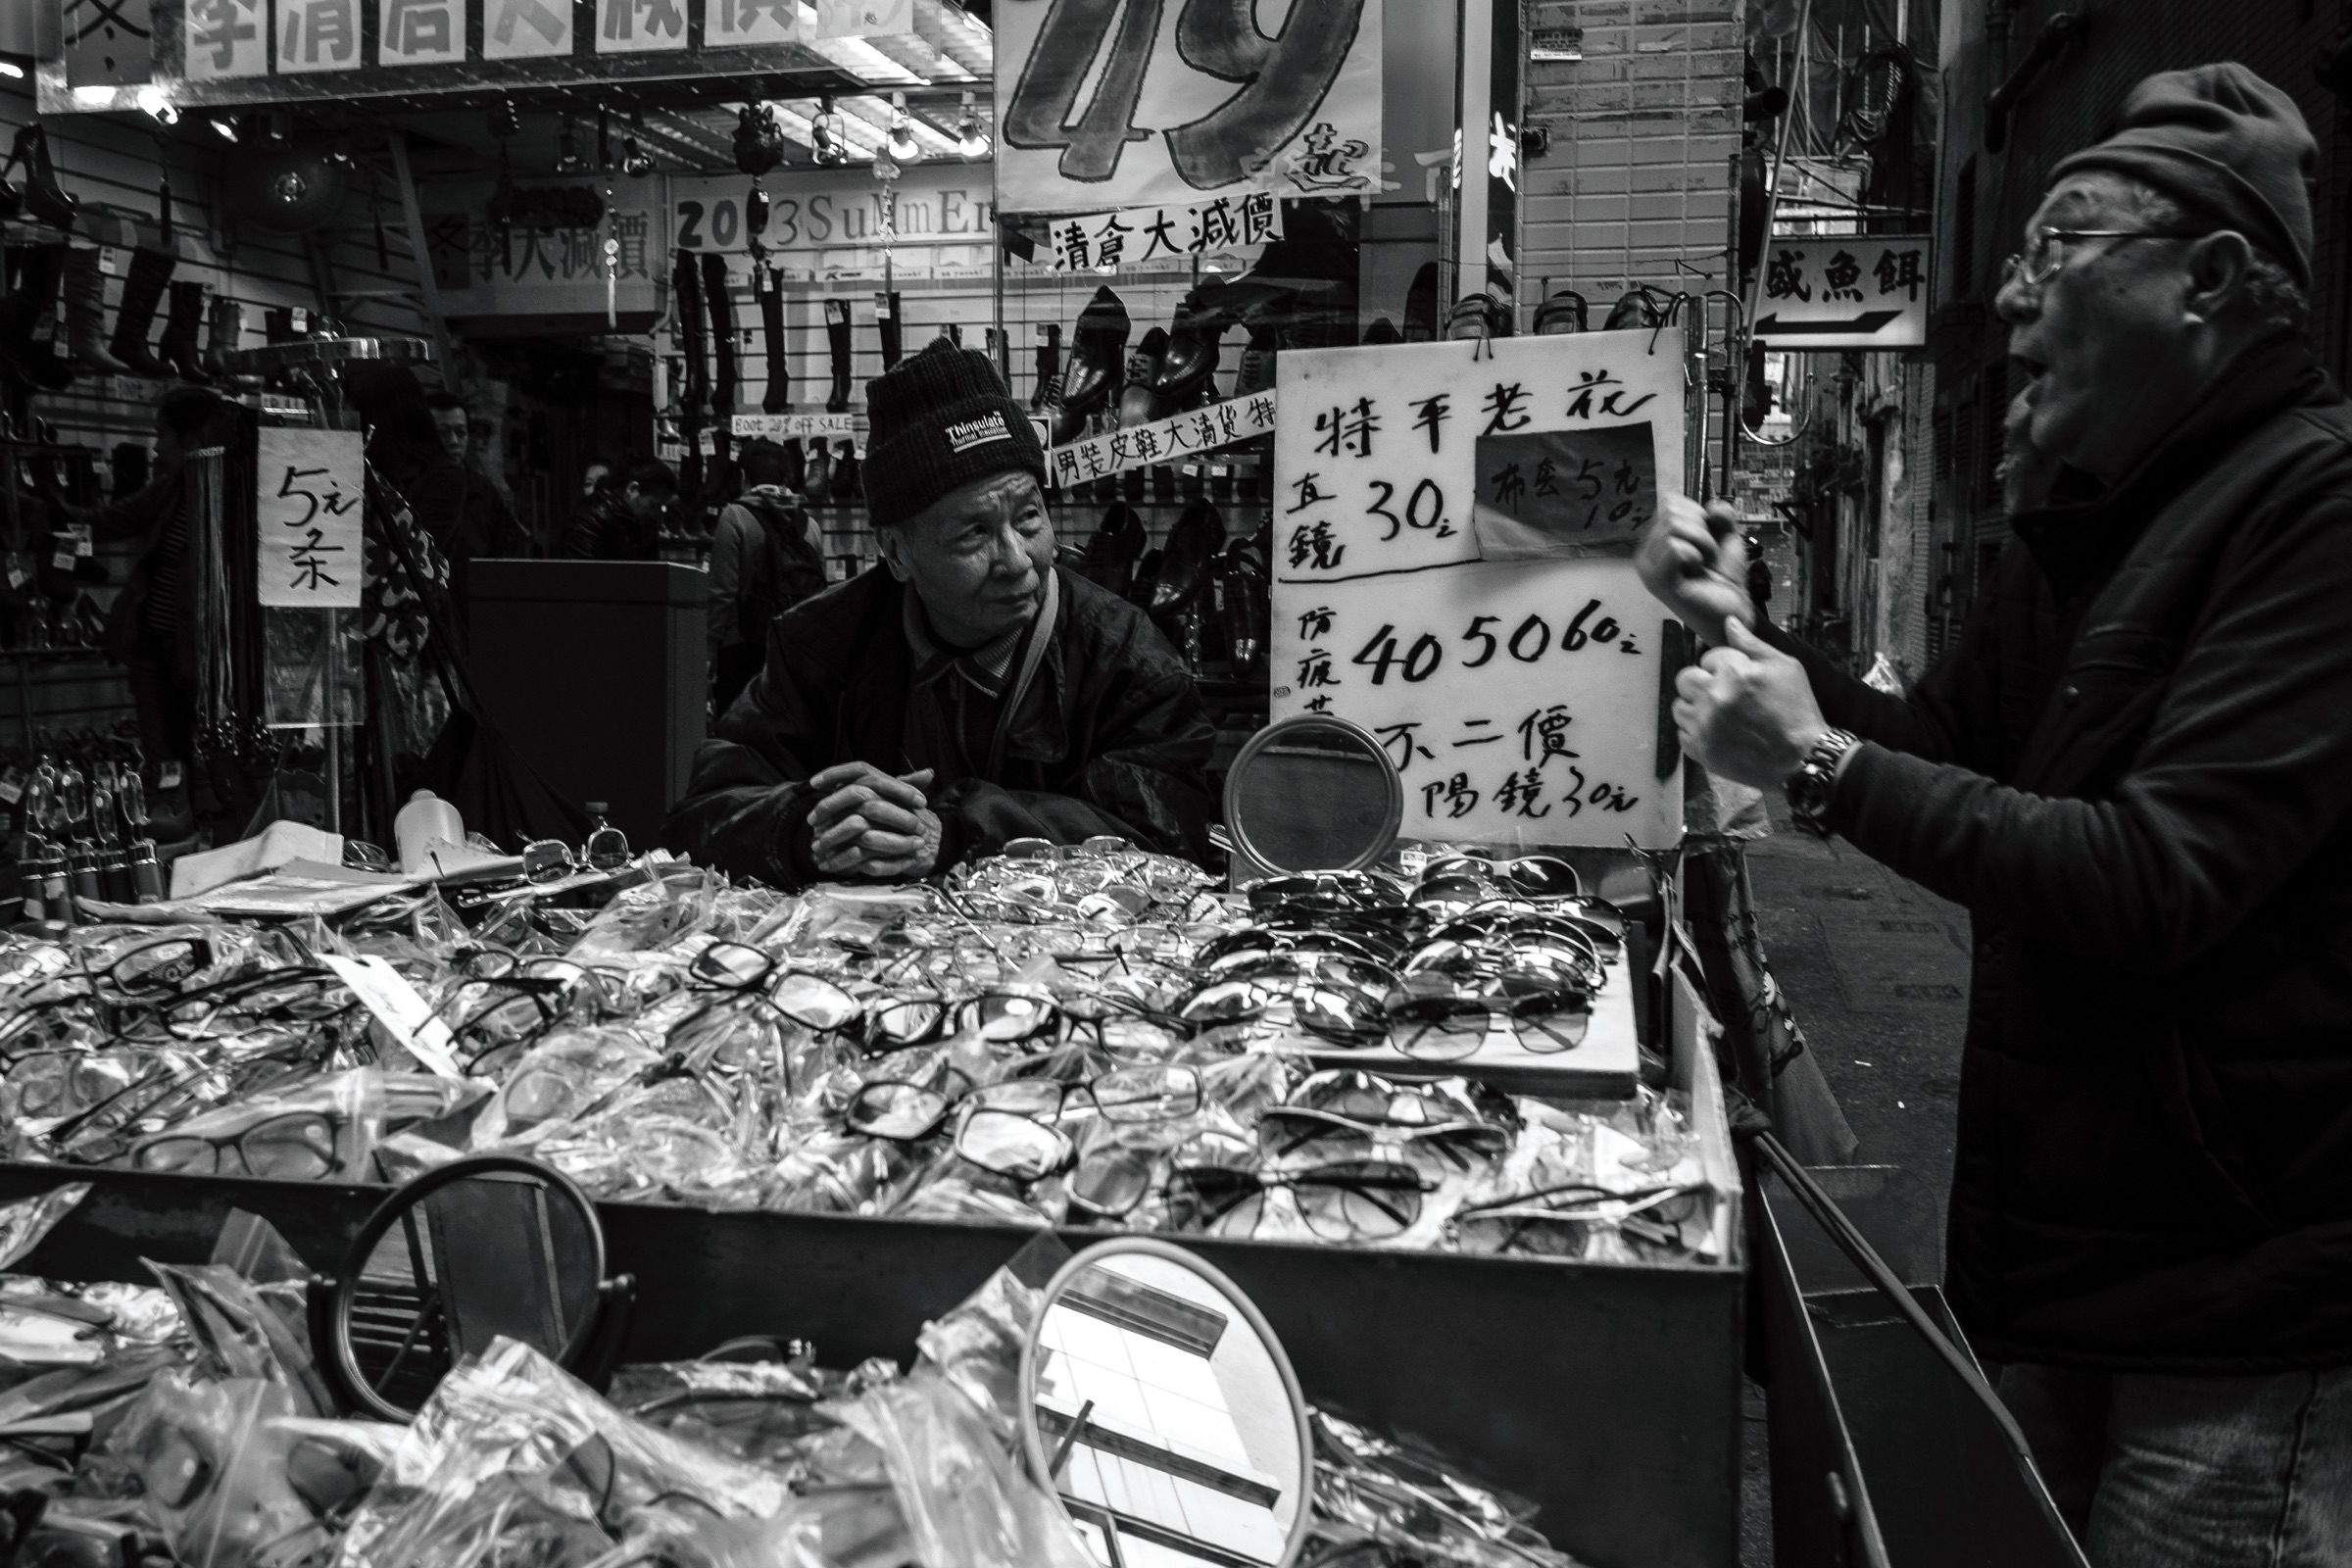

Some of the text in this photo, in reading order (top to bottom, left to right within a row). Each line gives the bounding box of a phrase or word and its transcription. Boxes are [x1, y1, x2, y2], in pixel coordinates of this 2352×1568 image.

[1054, 192, 1283, 272] 清倉大減價
[735, 417, 763, 433] Boot
[795, 416, 814, 434] off
[819, 416, 853, 432] SALE
[1351, 623, 1444, 685] 40
[1461, 613, 1551, 667] 50
